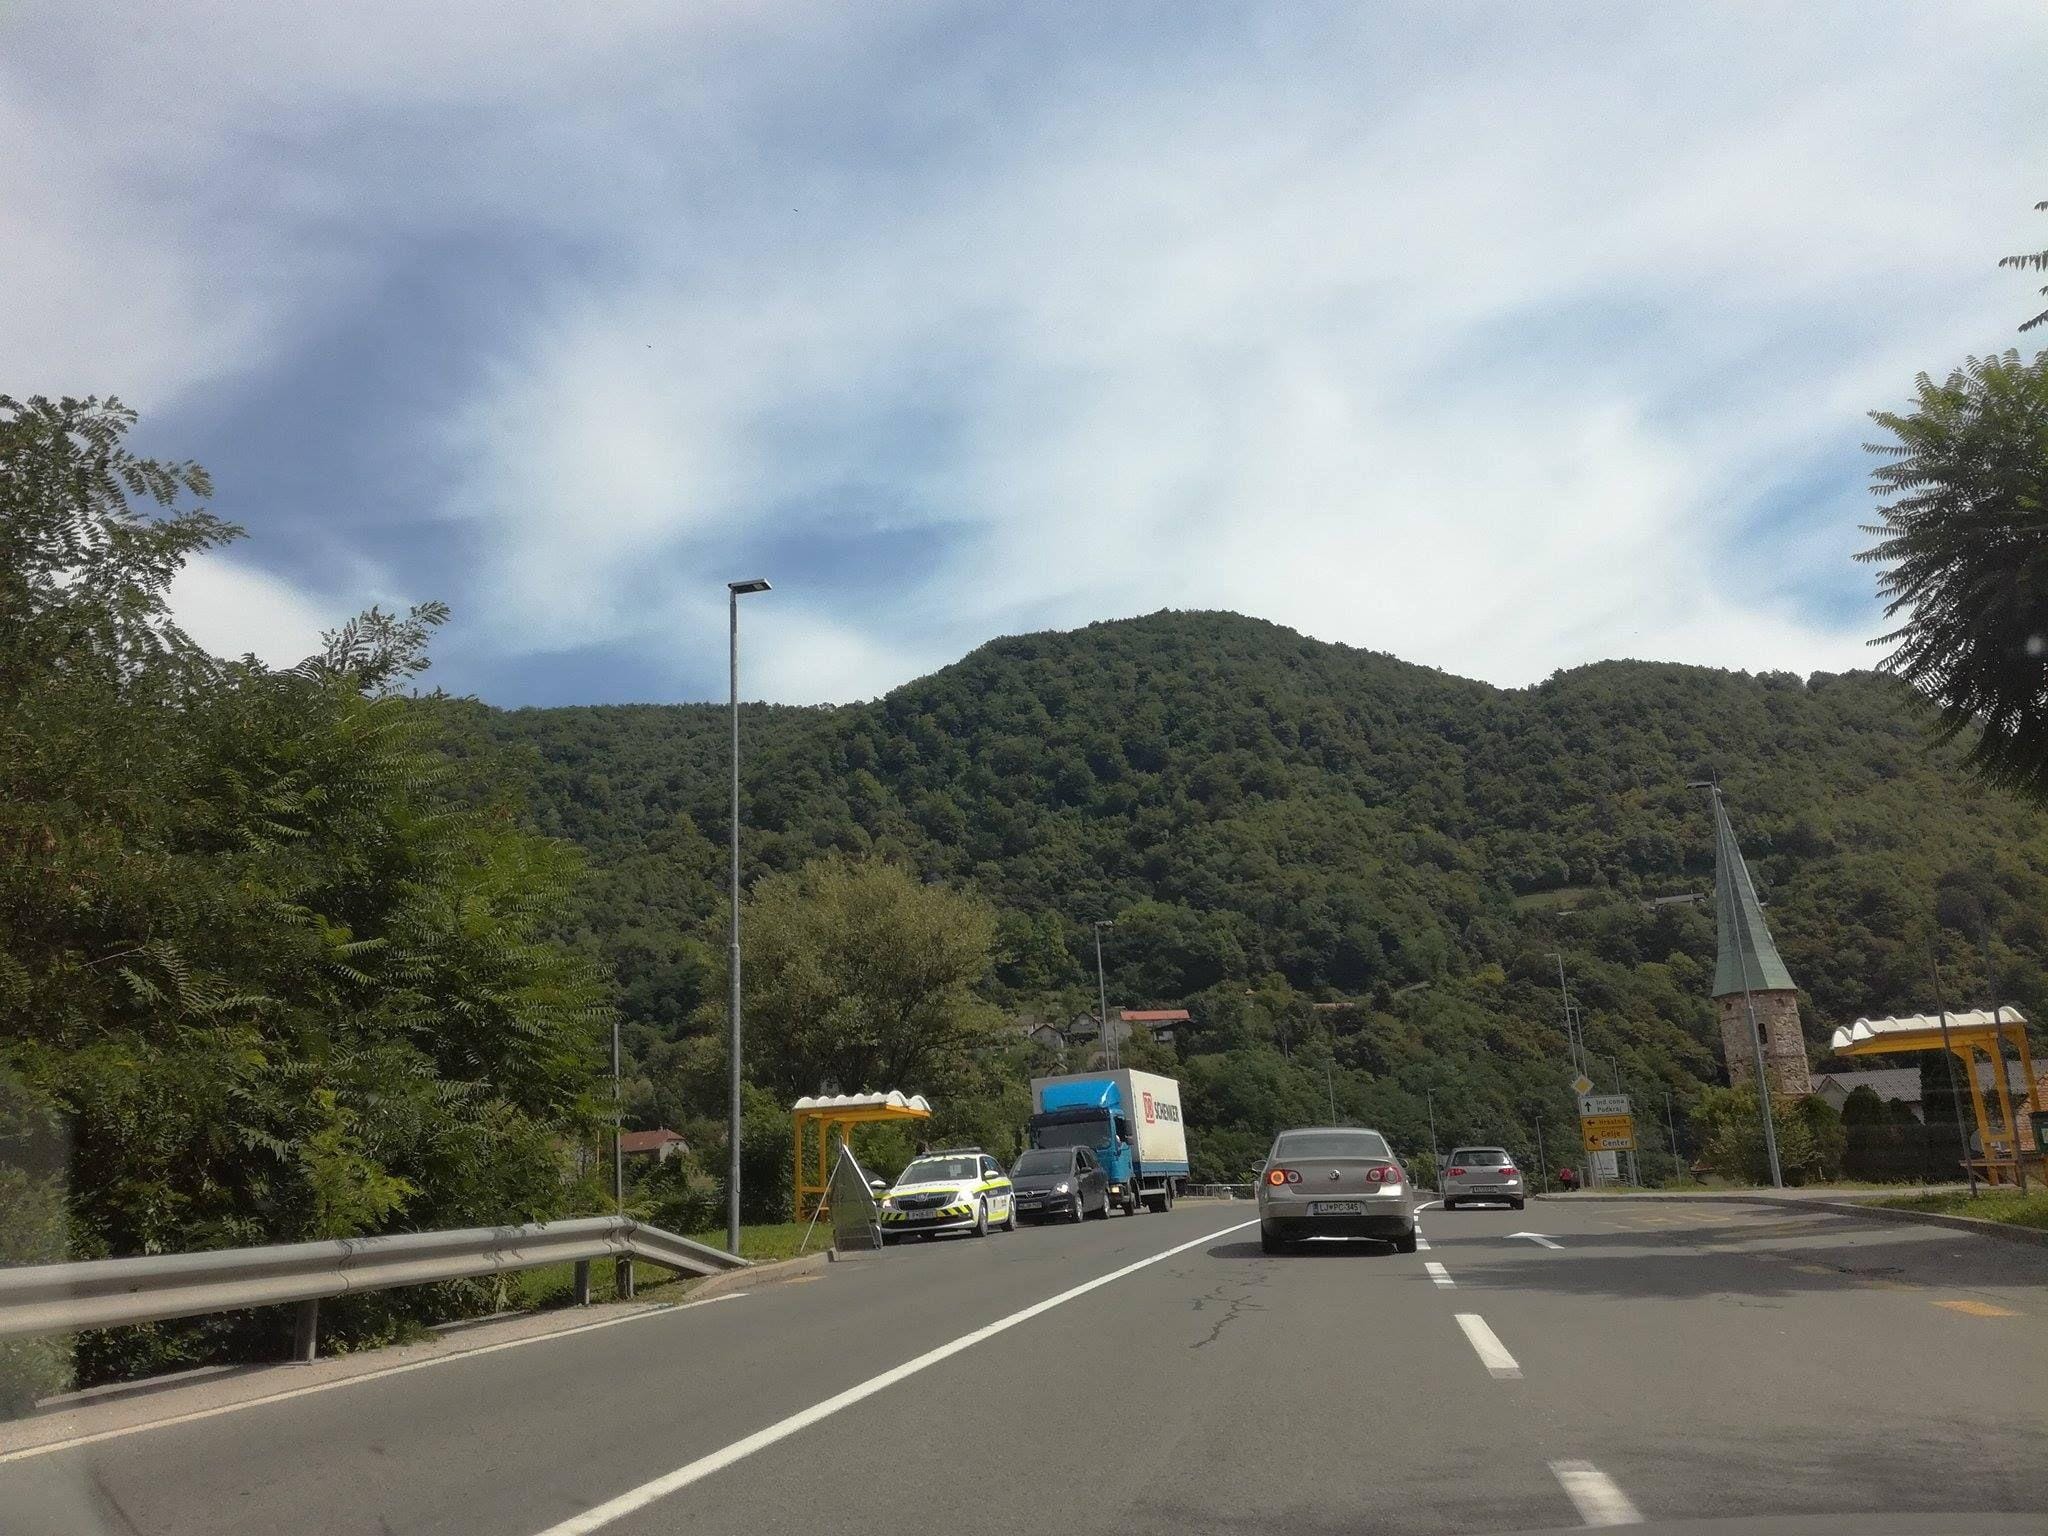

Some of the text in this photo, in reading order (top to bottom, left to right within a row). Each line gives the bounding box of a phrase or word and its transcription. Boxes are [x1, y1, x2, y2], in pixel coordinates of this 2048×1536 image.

[1153, 1101, 1179, 1122] SCHENKER
[1601, 1130, 1621, 1138] Celje
[1602, 1139, 1628, 1147] Center
